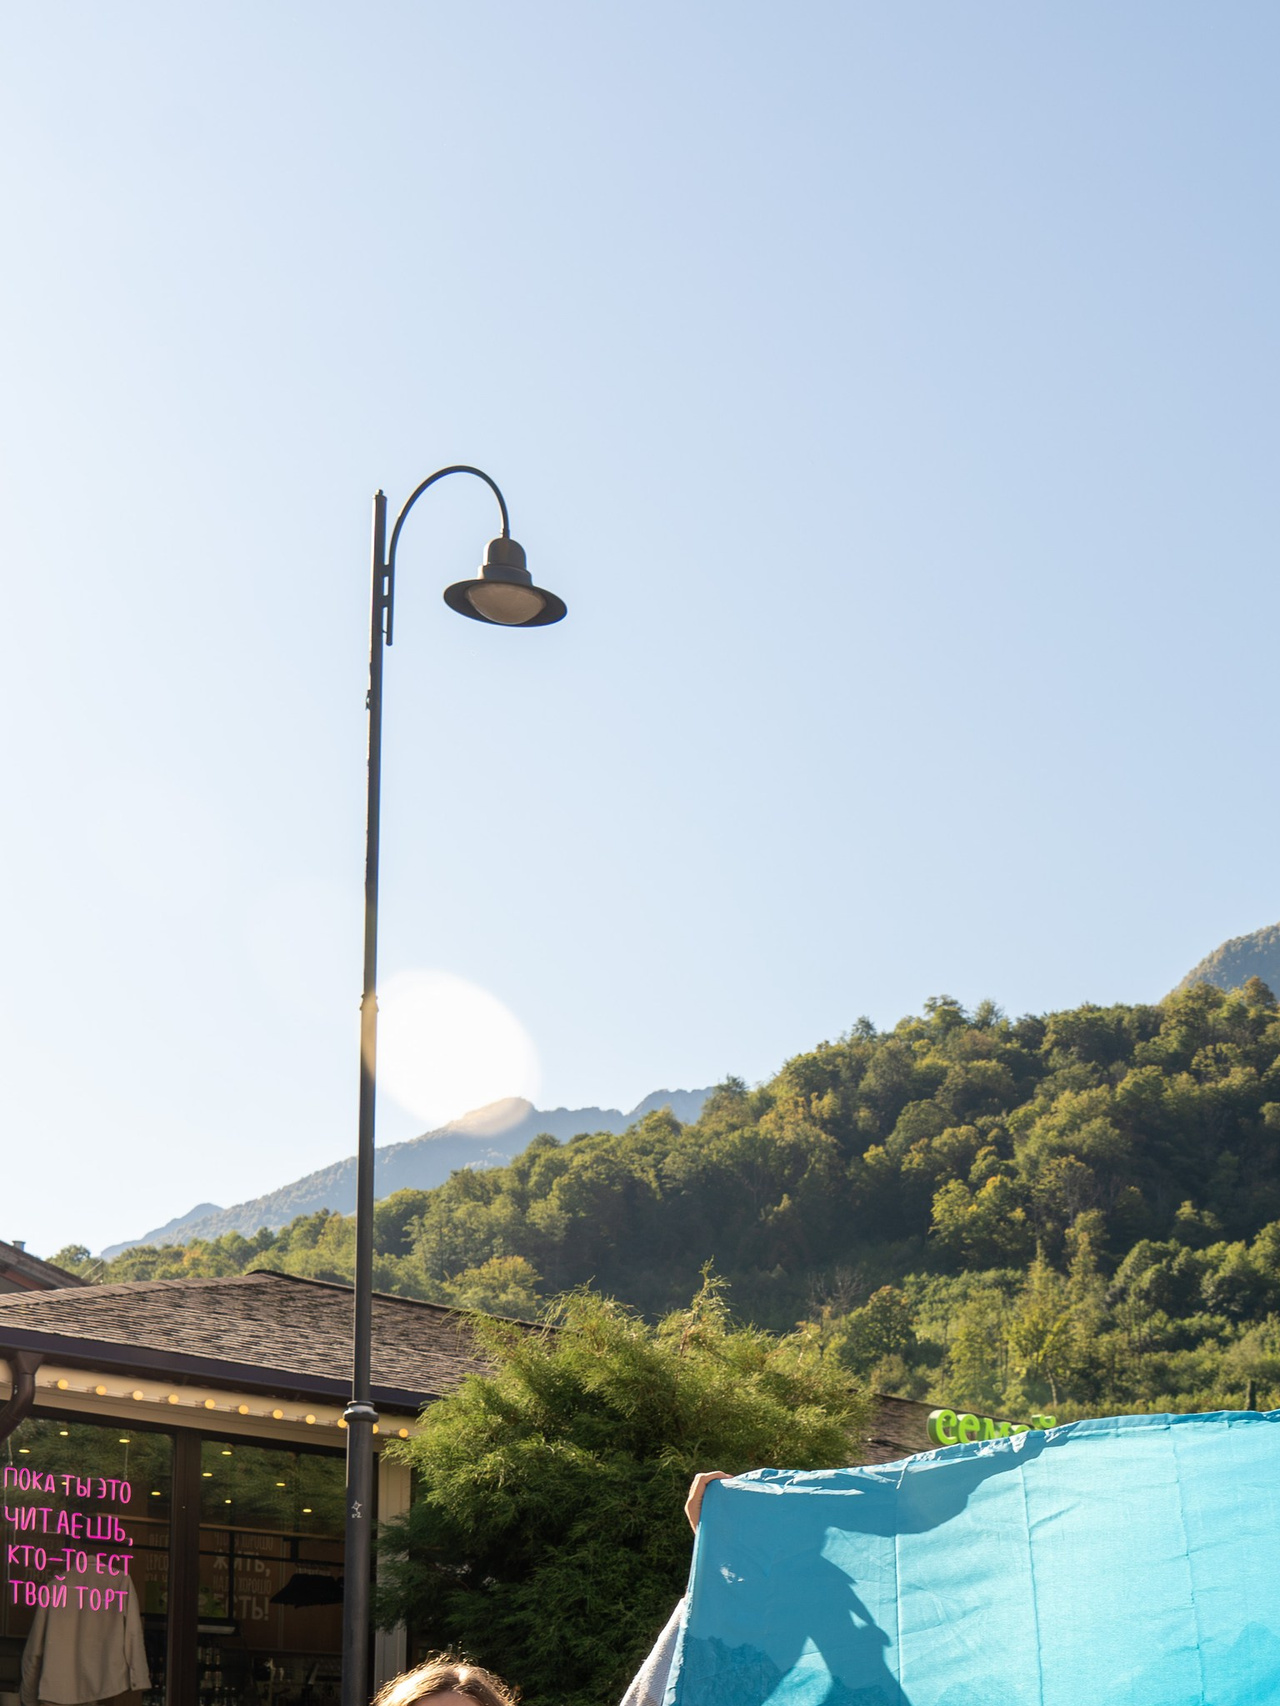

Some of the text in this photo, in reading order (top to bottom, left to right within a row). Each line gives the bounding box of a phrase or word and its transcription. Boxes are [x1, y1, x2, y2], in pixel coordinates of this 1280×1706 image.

[928, 1408, 1057, 1445] сем
[4, 1467, 132, 1504] ПОКА ТЫ ЭТО
[4, 1506, 134, 1547] ЧИТАЕШЬ,
[7, 1544, 88, 1574] КТО-ТО
[96, 1552, 134, 1576] ЕСТ
[8, 1574, 67, 1608] ТВОЙ
[75, 1585, 129, 1613] ТОРТ
[213, 1593, 270, 1621] ТЬ!
